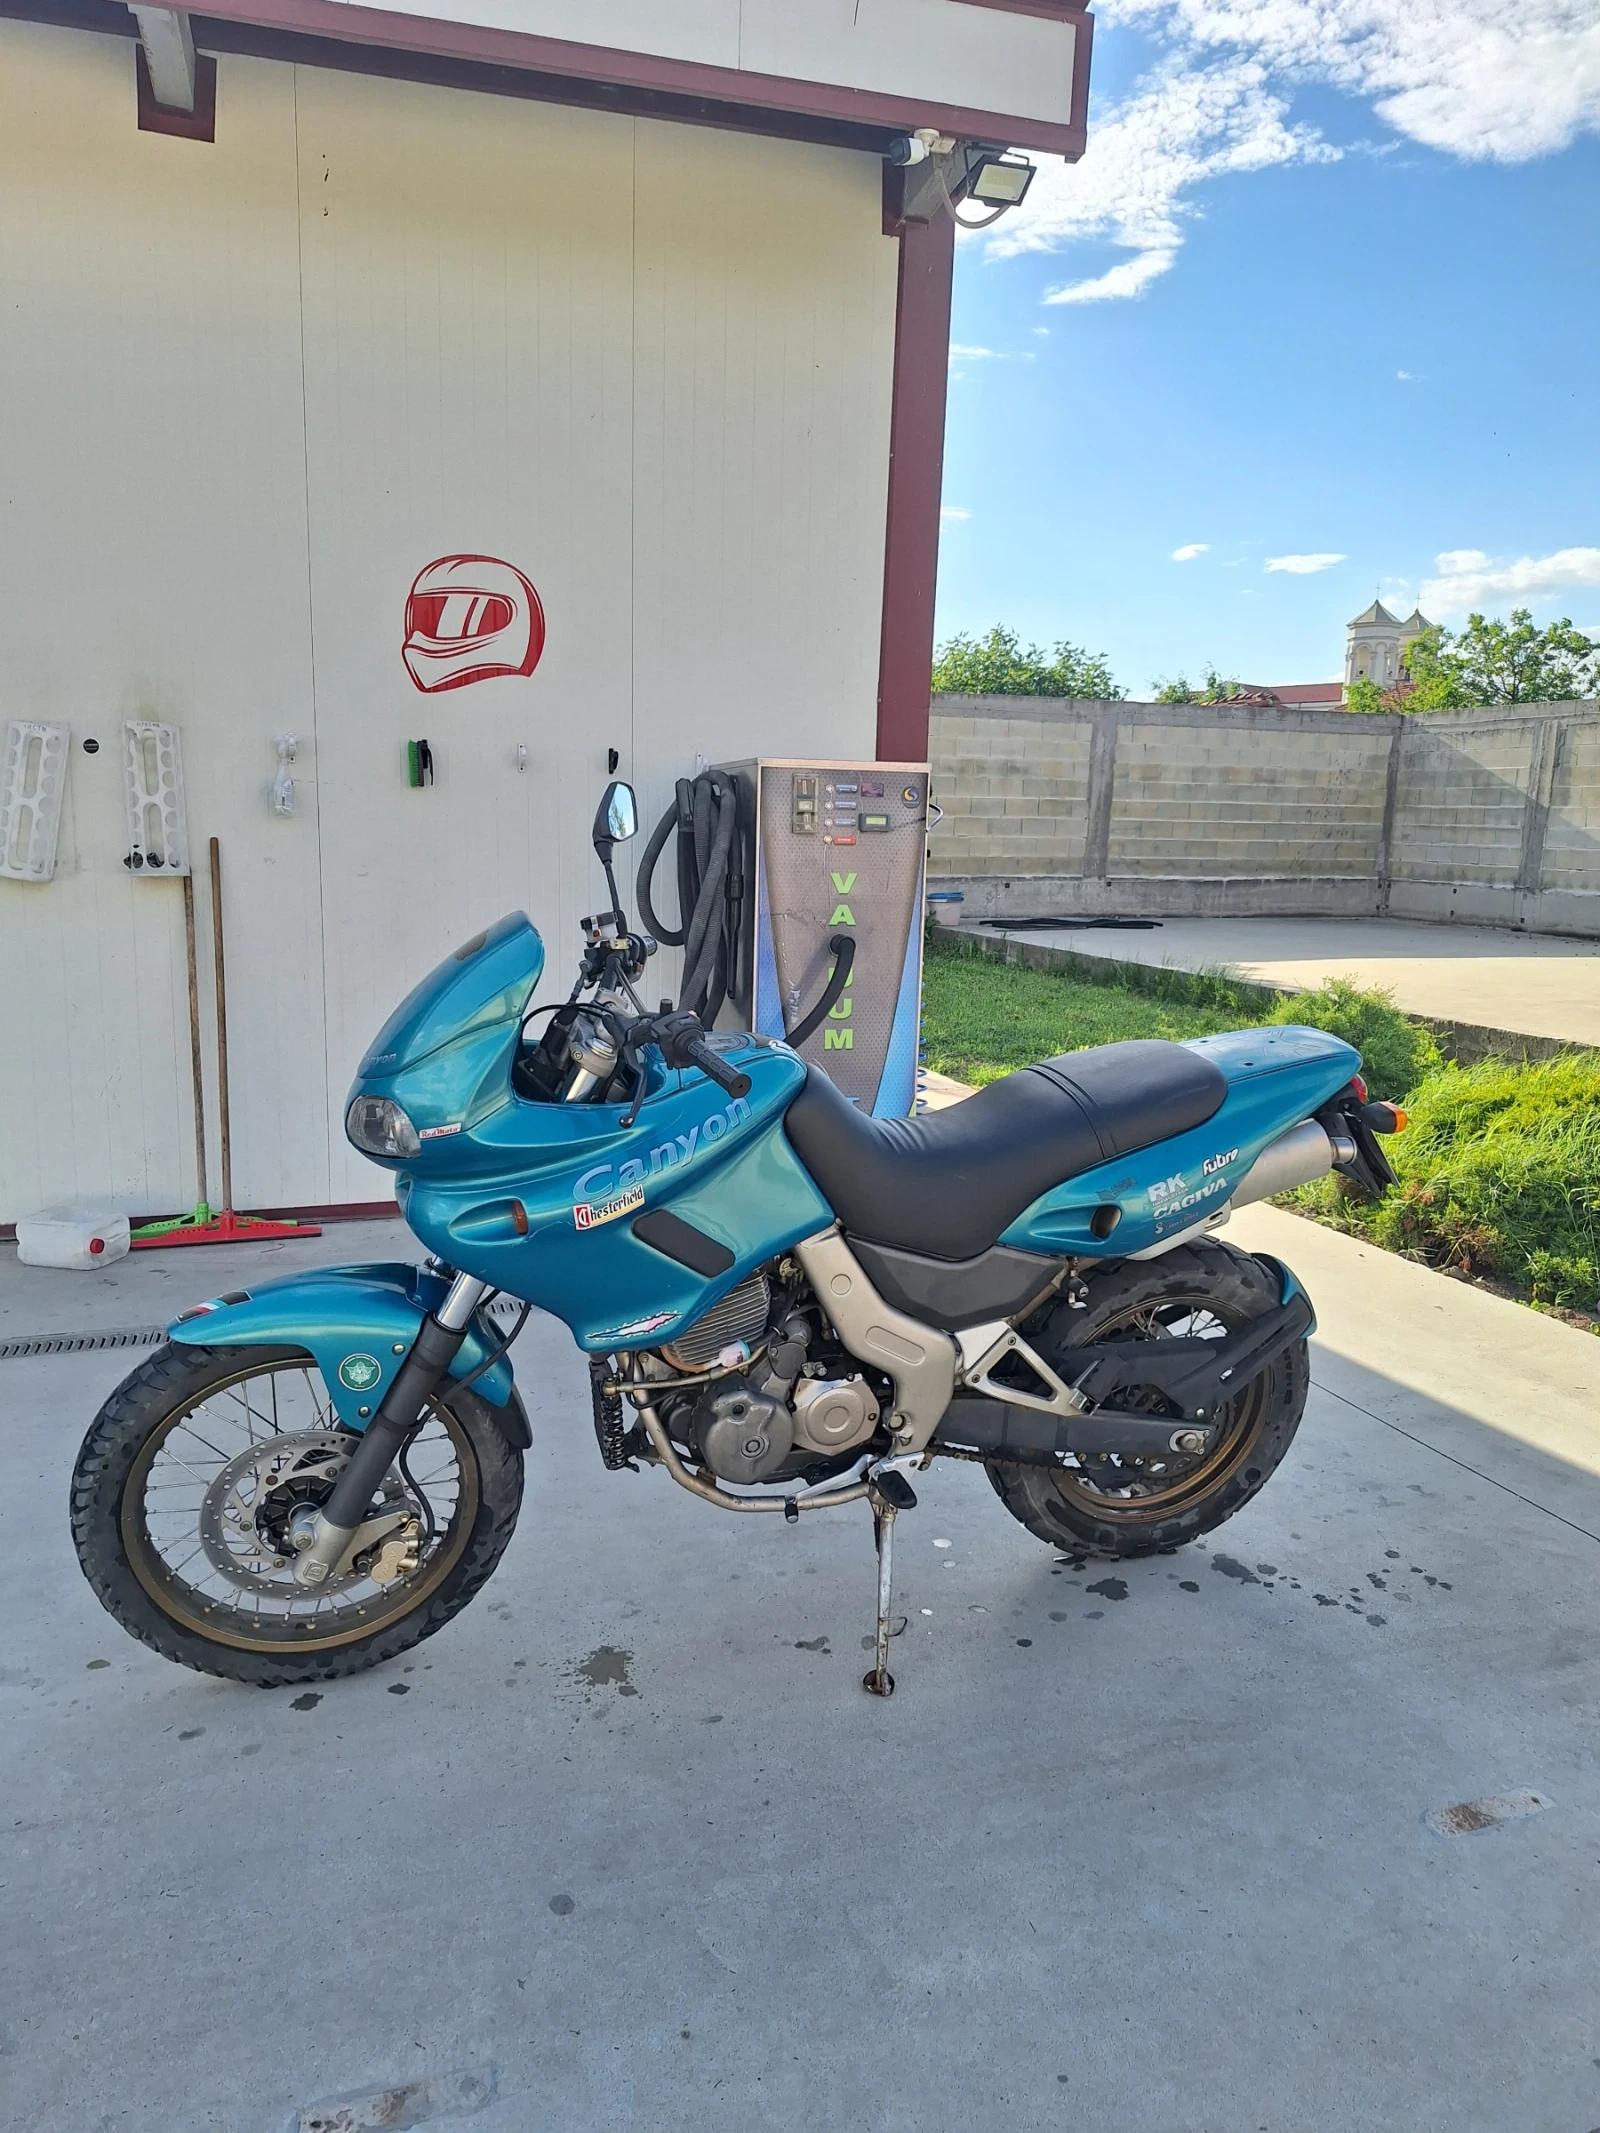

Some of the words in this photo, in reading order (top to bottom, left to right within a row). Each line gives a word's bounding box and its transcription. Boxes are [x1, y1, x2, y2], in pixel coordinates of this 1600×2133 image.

[824, 872, 858, 1050] VAUUM
[573, 1098, 752, 1203] Canyon
[576, 1185, 643, 1228] Chesterfield
[1147, 1172, 1187, 1202] RK
[1153, 1178, 1228, 1220] CAGIVA
